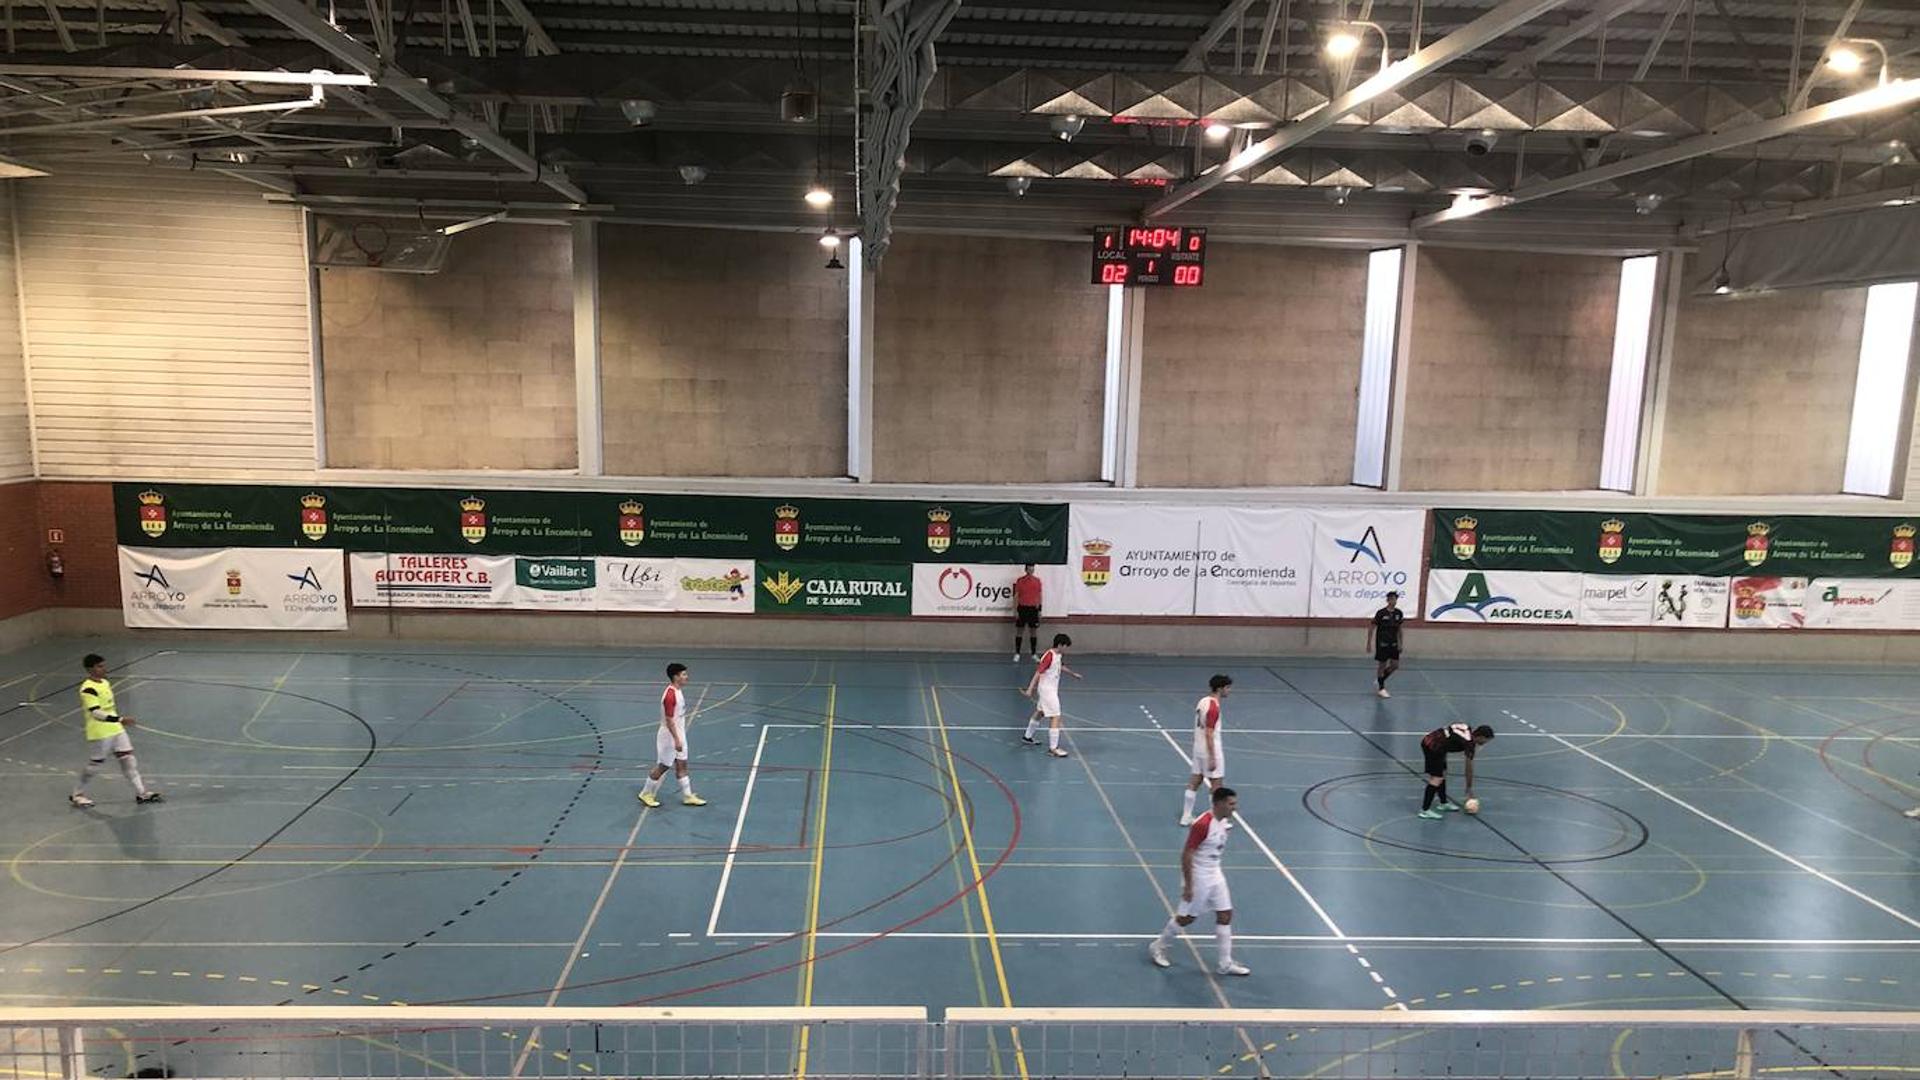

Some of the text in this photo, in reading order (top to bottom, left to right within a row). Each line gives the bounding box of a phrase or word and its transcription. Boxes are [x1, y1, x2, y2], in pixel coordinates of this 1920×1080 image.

[1105, 234, 1111, 249] 1
[1129, 228, 1179, 248] 14:04
[1188, 236, 1200, 251] 0
[1097, 250, 1126, 260] LOCAL
[1102, 264, 1128, 283] 02
[1174, 265, 1201, 285] 00
[223, 510, 232, 518] de
[383, 512, 392, 520] de
[542, 516, 551, 524] de
[173, 520, 274, 532] Arroyo de La Encomienda
[333, 523, 434, 534] Arroyo de La Encomienda
[699, 520, 708, 528] de
[492, 526, 593, 537] Arroyo de La Encomienda
[650, 529, 749, 541] Arroyo de La Encomienda
[1004, 527, 1013, 535] de
[804, 533, 901, 545] Arroyo de La Encomienda
[956, 537, 1051, 547] Arroyo de La Encomienda
[1820, 540, 1828, 548] de
[1481, 544, 1574, 554] Arroyo de La Encomienda
[1626, 547, 1720, 558] Arroyo de La Encomienda
[1772, 550, 1865, 560] Arroyo de La Encomienda
[1126, 550, 1236, 562] AYUNTAMIENTO de
[398, 556, 468, 570] TALLERES
[375, 570, 493, 584] AUTOCAFER C.B.
[1119, 564, 1168, 579] arroyo
[1173, 564, 1190, 578] de
[1211, 564, 1296, 579] encomienda
[1323, 570, 1407, 586] ARROYO
[806, 579, 907, 598] CAJA RURAL
[1354, 588, 1406, 601] depoe
[1584, 586, 1627, 601] marpel
[130, 591, 185, 602] ARROYO
[284, 594, 338, 604] ARROYO
[806, 597, 861, 606] DE ZAMORA
[1490, 607, 1573, 620] AGROCESA
